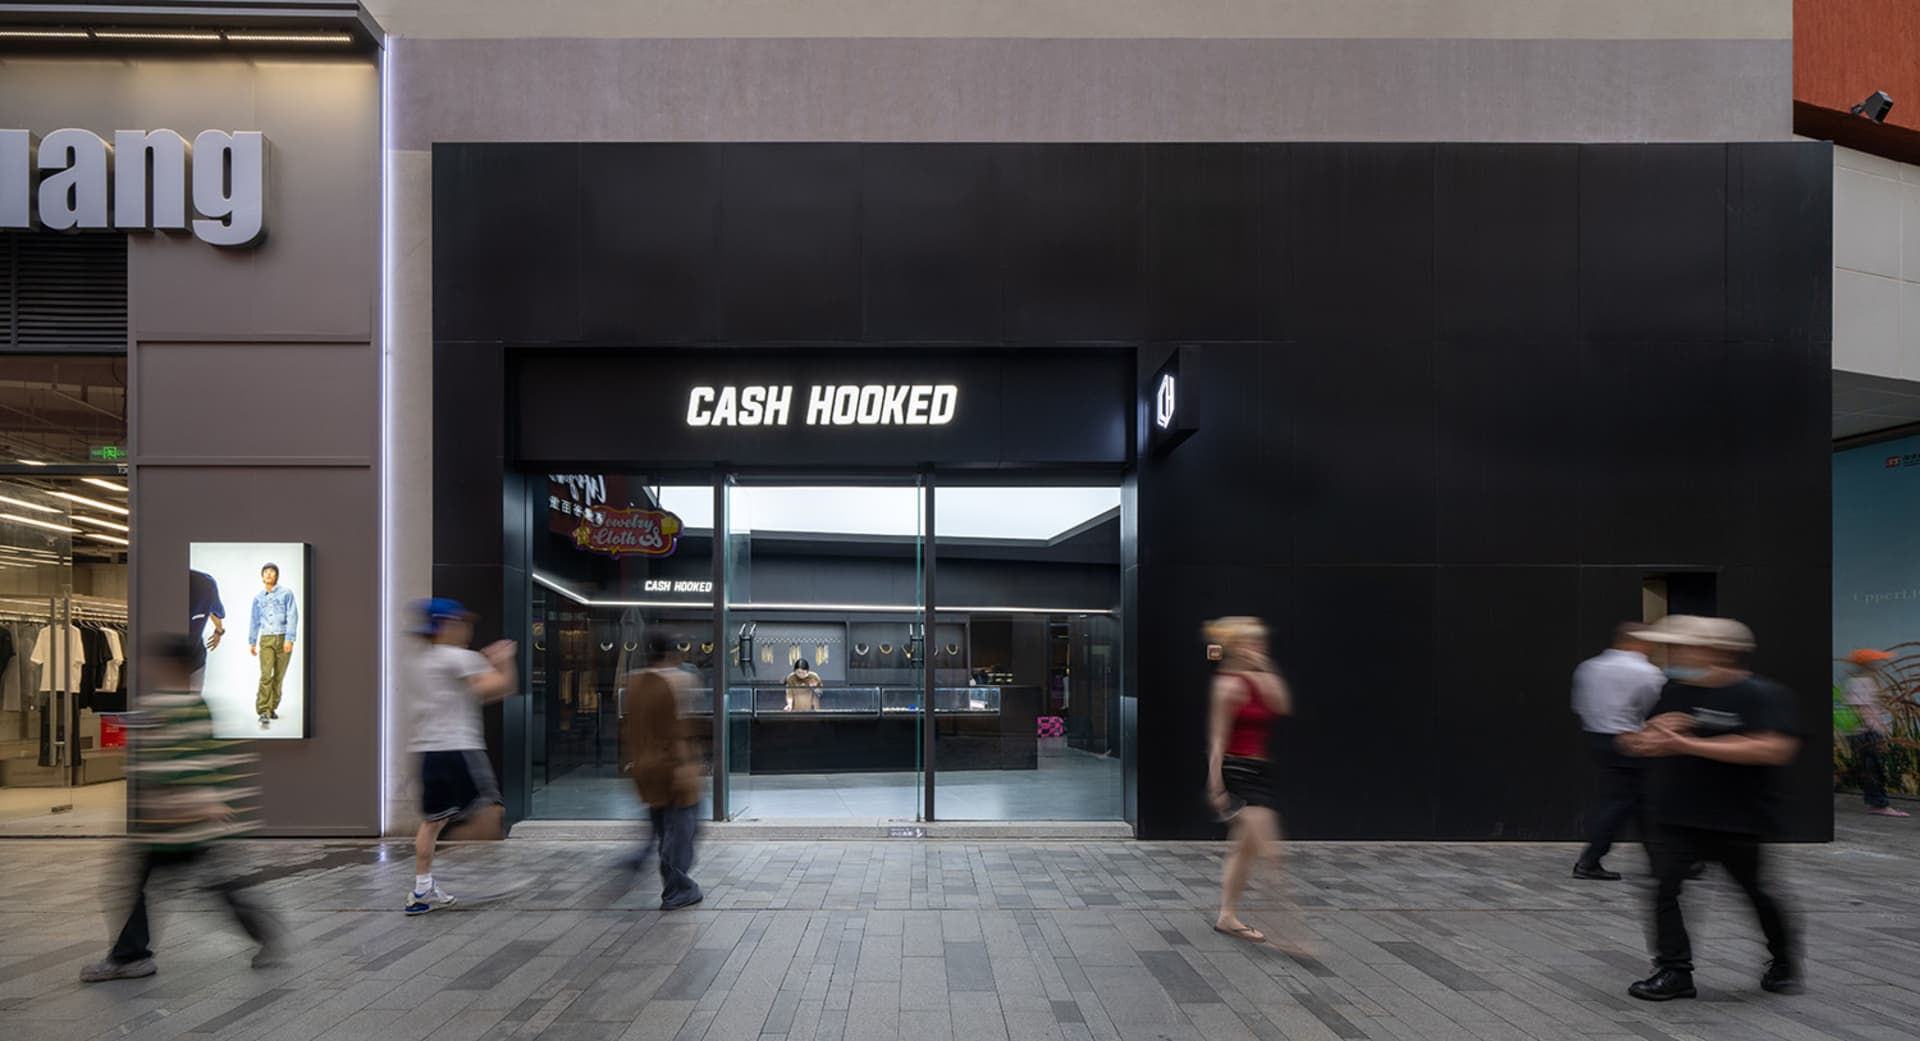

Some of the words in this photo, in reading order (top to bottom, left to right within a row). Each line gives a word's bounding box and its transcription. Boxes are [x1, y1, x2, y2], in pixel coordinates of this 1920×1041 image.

[686, 385, 793, 426] CASH
[806, 384, 958, 426] HOOKED
[644, 579, 672, 592] CASH
[673, 580, 713, 593] HOOKED
